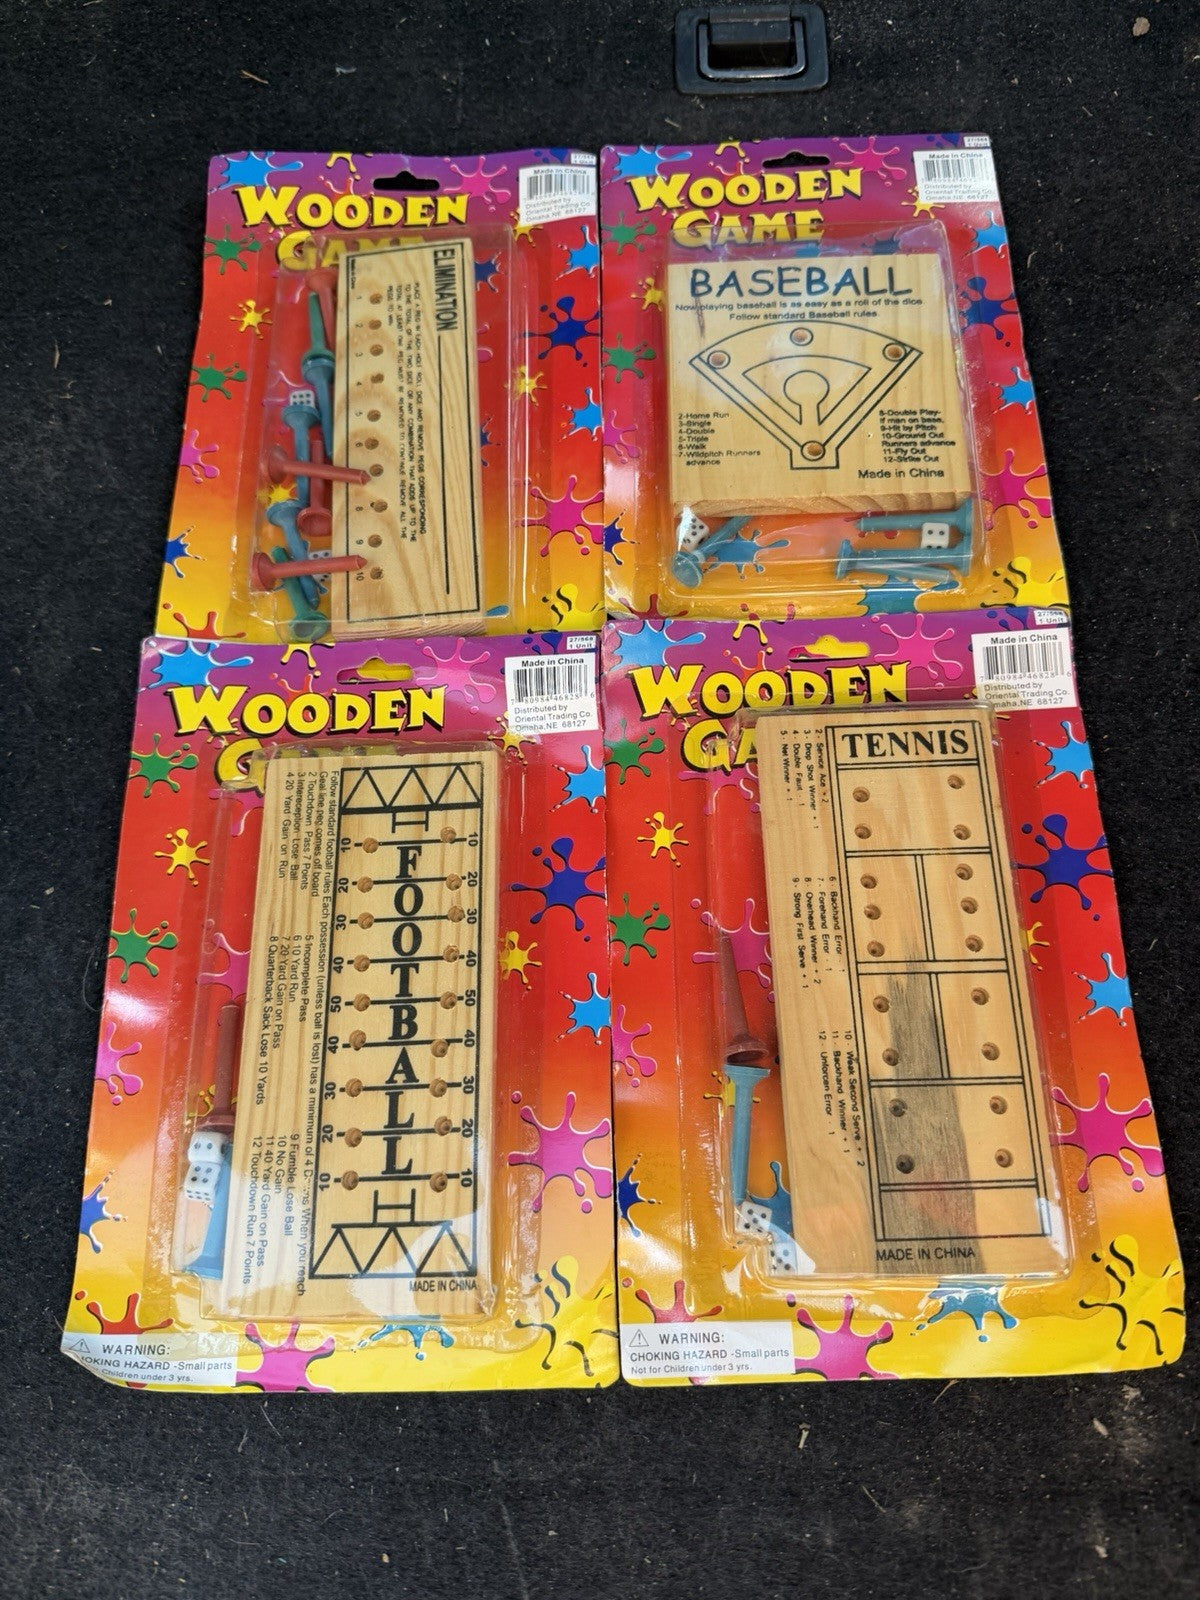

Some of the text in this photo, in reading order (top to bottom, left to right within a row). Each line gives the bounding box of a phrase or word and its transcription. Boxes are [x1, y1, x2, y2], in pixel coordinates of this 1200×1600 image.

[625, 168, 863, 212] WOODEN
[233, 186, 469, 228] WOODEN
[671, 209, 825, 251] GAME
[434, 248, 459, 332] ELIMINATION
[690, 266, 912, 298] BASEBALL
[729, 313, 760, 321] Follow
[764, 312, 805, 321] standard
[809, 311, 850, 319] Baseball
[737, 300, 776, 309] baseball
[407, 418, 415, 462] COMBINATION
[858, 468, 945, 479] Made in China
[417, 476, 427, 534] CORRESPONDING
[991, 637, 1016, 645] Made
[1030, 634, 1058, 643] China
[521, 657, 585, 668] Made in China
[626, 660, 911, 721] WOODEN
[984, 682, 1043, 692] Distributed by
[985, 690, 1019, 700] Oriental
[1022, 689, 1054, 700] Trading
[165, 685, 447, 737] WOODEN
[514, 704, 568, 715] Distributed by
[514, 714, 546, 723] Oriental
[548, 712, 578, 722] Trading
[561, 719, 587, 728] 68127
[792, 743, 803, 768] Double
[803, 743, 814, 761] Drop
[841, 729, 969, 759] TENNIS
[815, 743, 827, 787] Service Ace
[328, 770, 340, 798] Follow
[808, 785, 818, 811] Winner
[326, 799, 339, 836] standard
[299, 779, 318, 890] Touchdown Pass Points
[313, 828, 323, 856] comes
[341, 837, 352, 853] 10
[467, 831, 479, 847] 10
[291, 838, 302, 859] Lose
[325, 838, 337, 870] football
[289, 864, 300, 881] Ball
[313, 858, 323, 870] off
[310, 872, 322, 897] board
[322, 872, 334, 893] rules
[338, 877, 349, 894] 20
[467, 871, 478, 888] 20
[320, 896, 332, 919] Each
[792, 892, 804, 918] Strong
[805, 892, 817, 930] Overhead
[818, 891, 829, 929] Forehand
[830, 891, 844, 955] Backhand Error
[317, 921, 329, 973] possession
[298, 943, 313, 1022] Incomplete Pass
[313, 975, 326, 1010] (unless
[330, 995, 342, 1013] 50
[464, 989, 476, 1006] 50
[313, 1012, 325, 1029] ball
[381, 846, 424, 1175] FOOTBALL
[256, 945, 278, 1105] Quarterback Sack Lose 10 Yards
[309, 1067, 319, 1084] has
[848, 1078, 859, 1112] Second
[247, 1152, 262, 1211] Touchdown
[283, 1143, 299, 1236] Fumble Lose Ball
[318, 1172, 331, 1191] 10
[246, 1214, 257, 1237] Run
[876, 1246, 976, 1261] MADE IN CHINA
[409, 1280, 477, 1292] MADE IN CHINA
[102, 1344, 170, 1356] WARNING:
[659, 1332, 725, 1345] WARNING:
[81, 1356, 120, 1368] OKING
[124, 1359, 170, 1371] HAZARD
[207, 1361, 232, 1373] parts
[630, 1350, 680, 1363] CHOKING
[683, 1349, 728, 1360] HAZARD
[764, 1348, 790, 1360] parts
[141, 1372, 167, 1382] under
[631, 1366, 647, 1375] Not
[649, 1365, 661, 1374] for
[664, 1363, 699, 1373] Children
[699, 1362, 728, 1372] under
